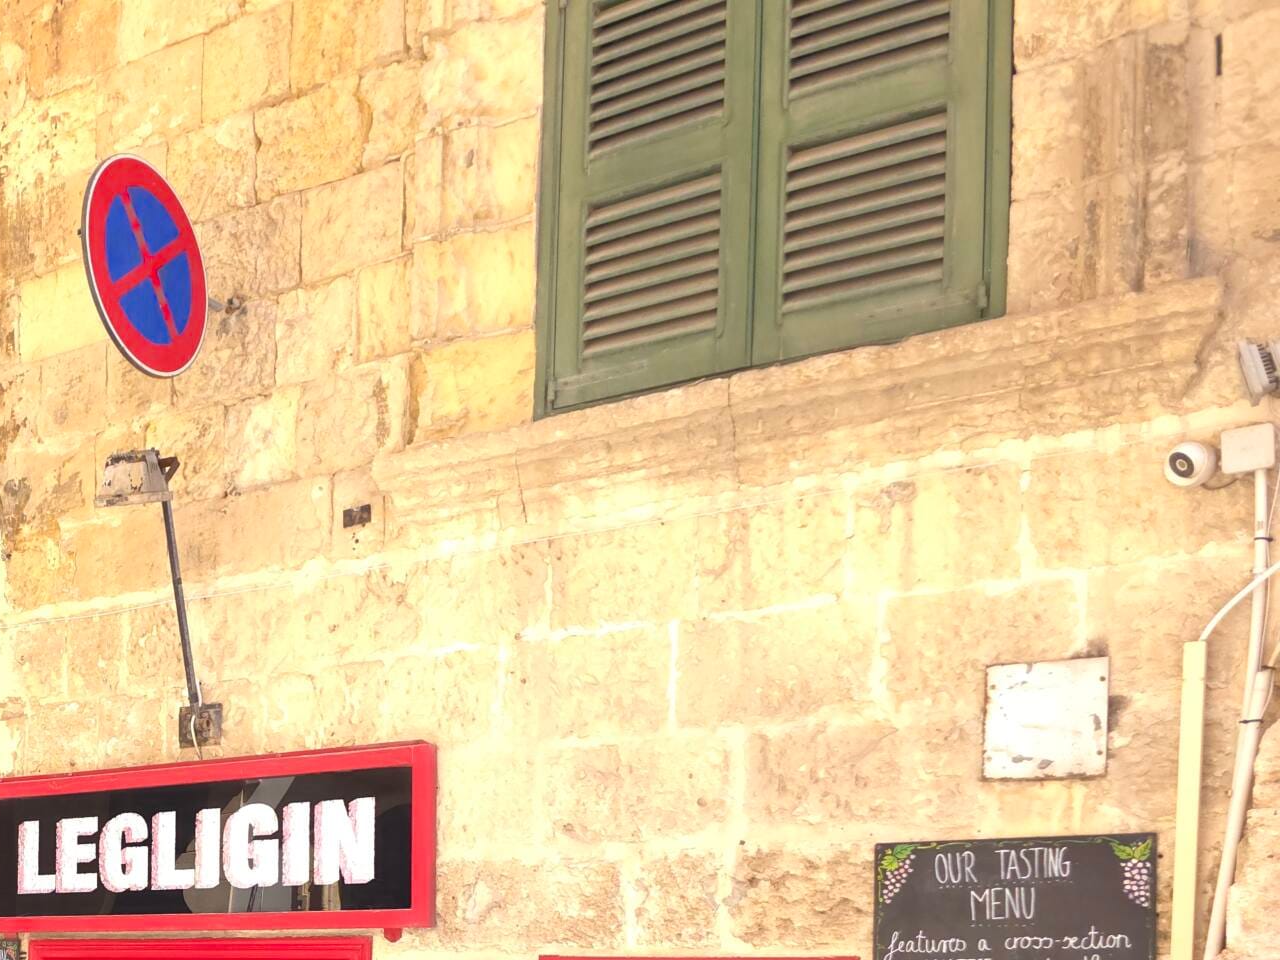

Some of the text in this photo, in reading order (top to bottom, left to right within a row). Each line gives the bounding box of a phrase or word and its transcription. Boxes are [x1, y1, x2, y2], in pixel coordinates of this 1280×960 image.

[17, 796, 376, 895] LEGLIGIN
[934, 846, 1072, 884] OUR TASTING
[970, 887, 1036, 921] MENU
[977, 938, 992, 952] a
[1004, 926, 1132, 950] cross-section
